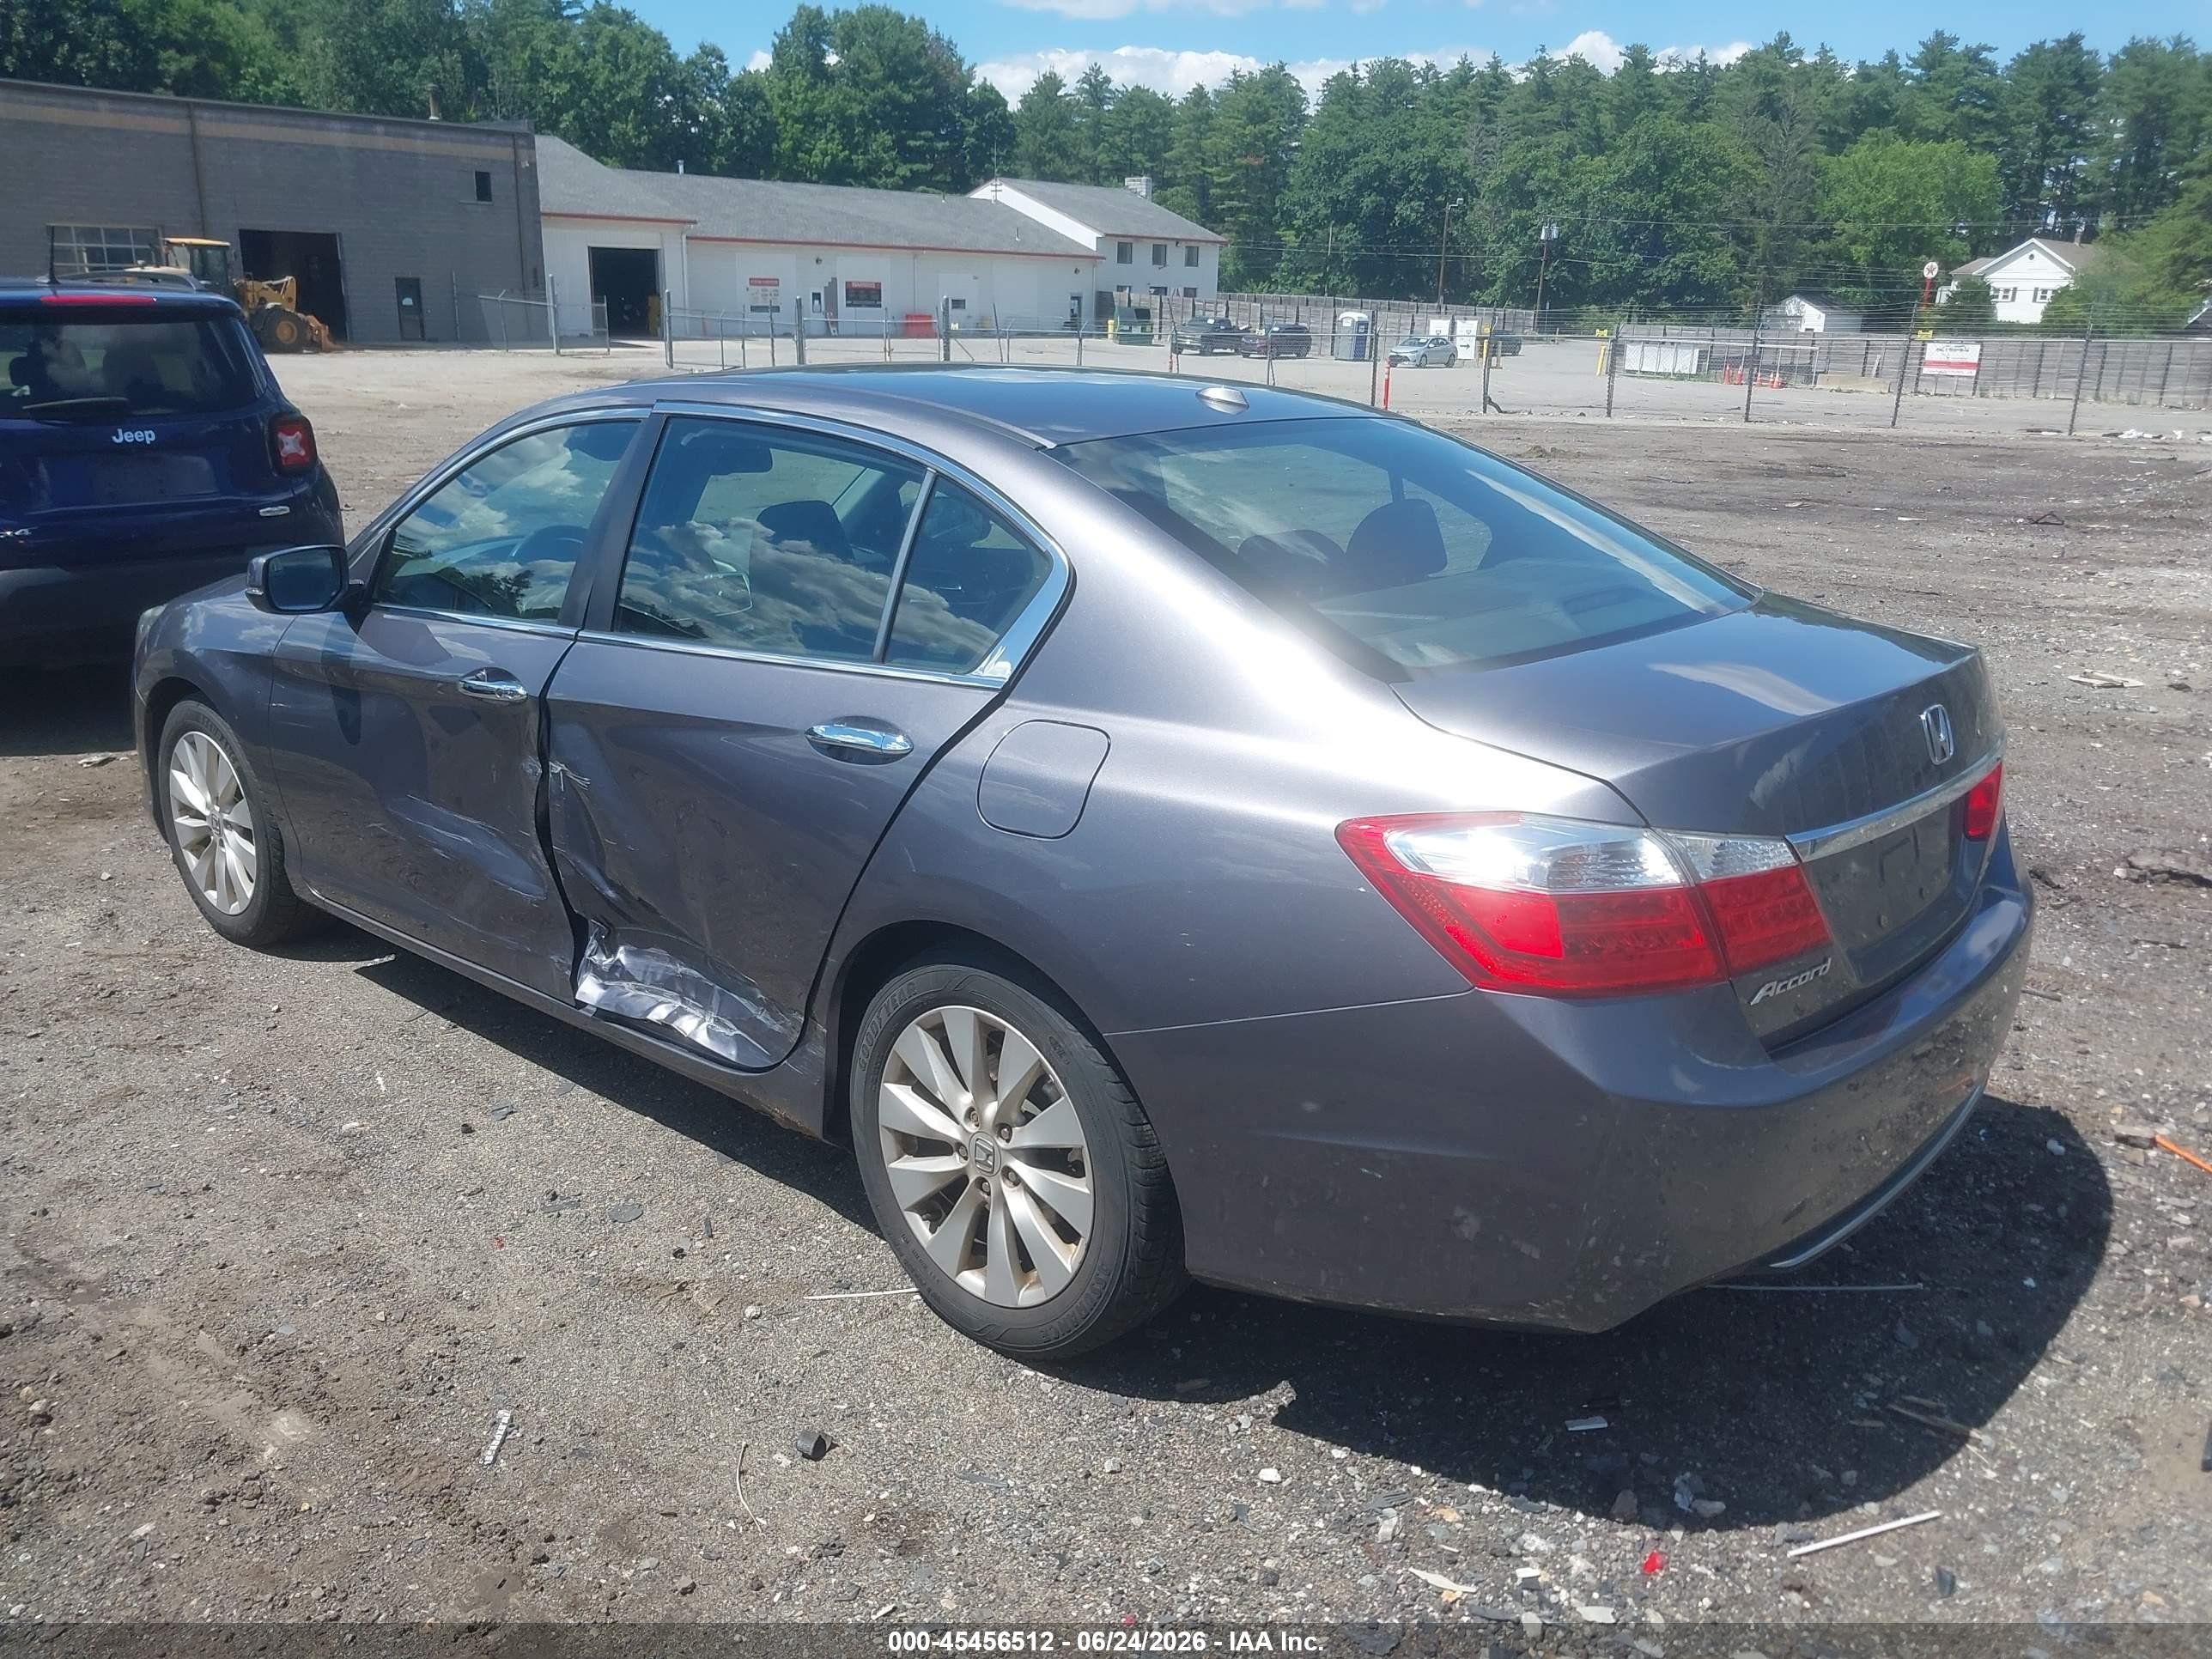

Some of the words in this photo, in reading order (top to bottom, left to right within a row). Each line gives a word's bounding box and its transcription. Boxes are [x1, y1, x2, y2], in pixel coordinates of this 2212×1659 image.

[111, 428, 156, 445] Jeep
[1750, 957, 1832, 1006] Accord
[858, 981, 920, 1073] GOODYEAR
